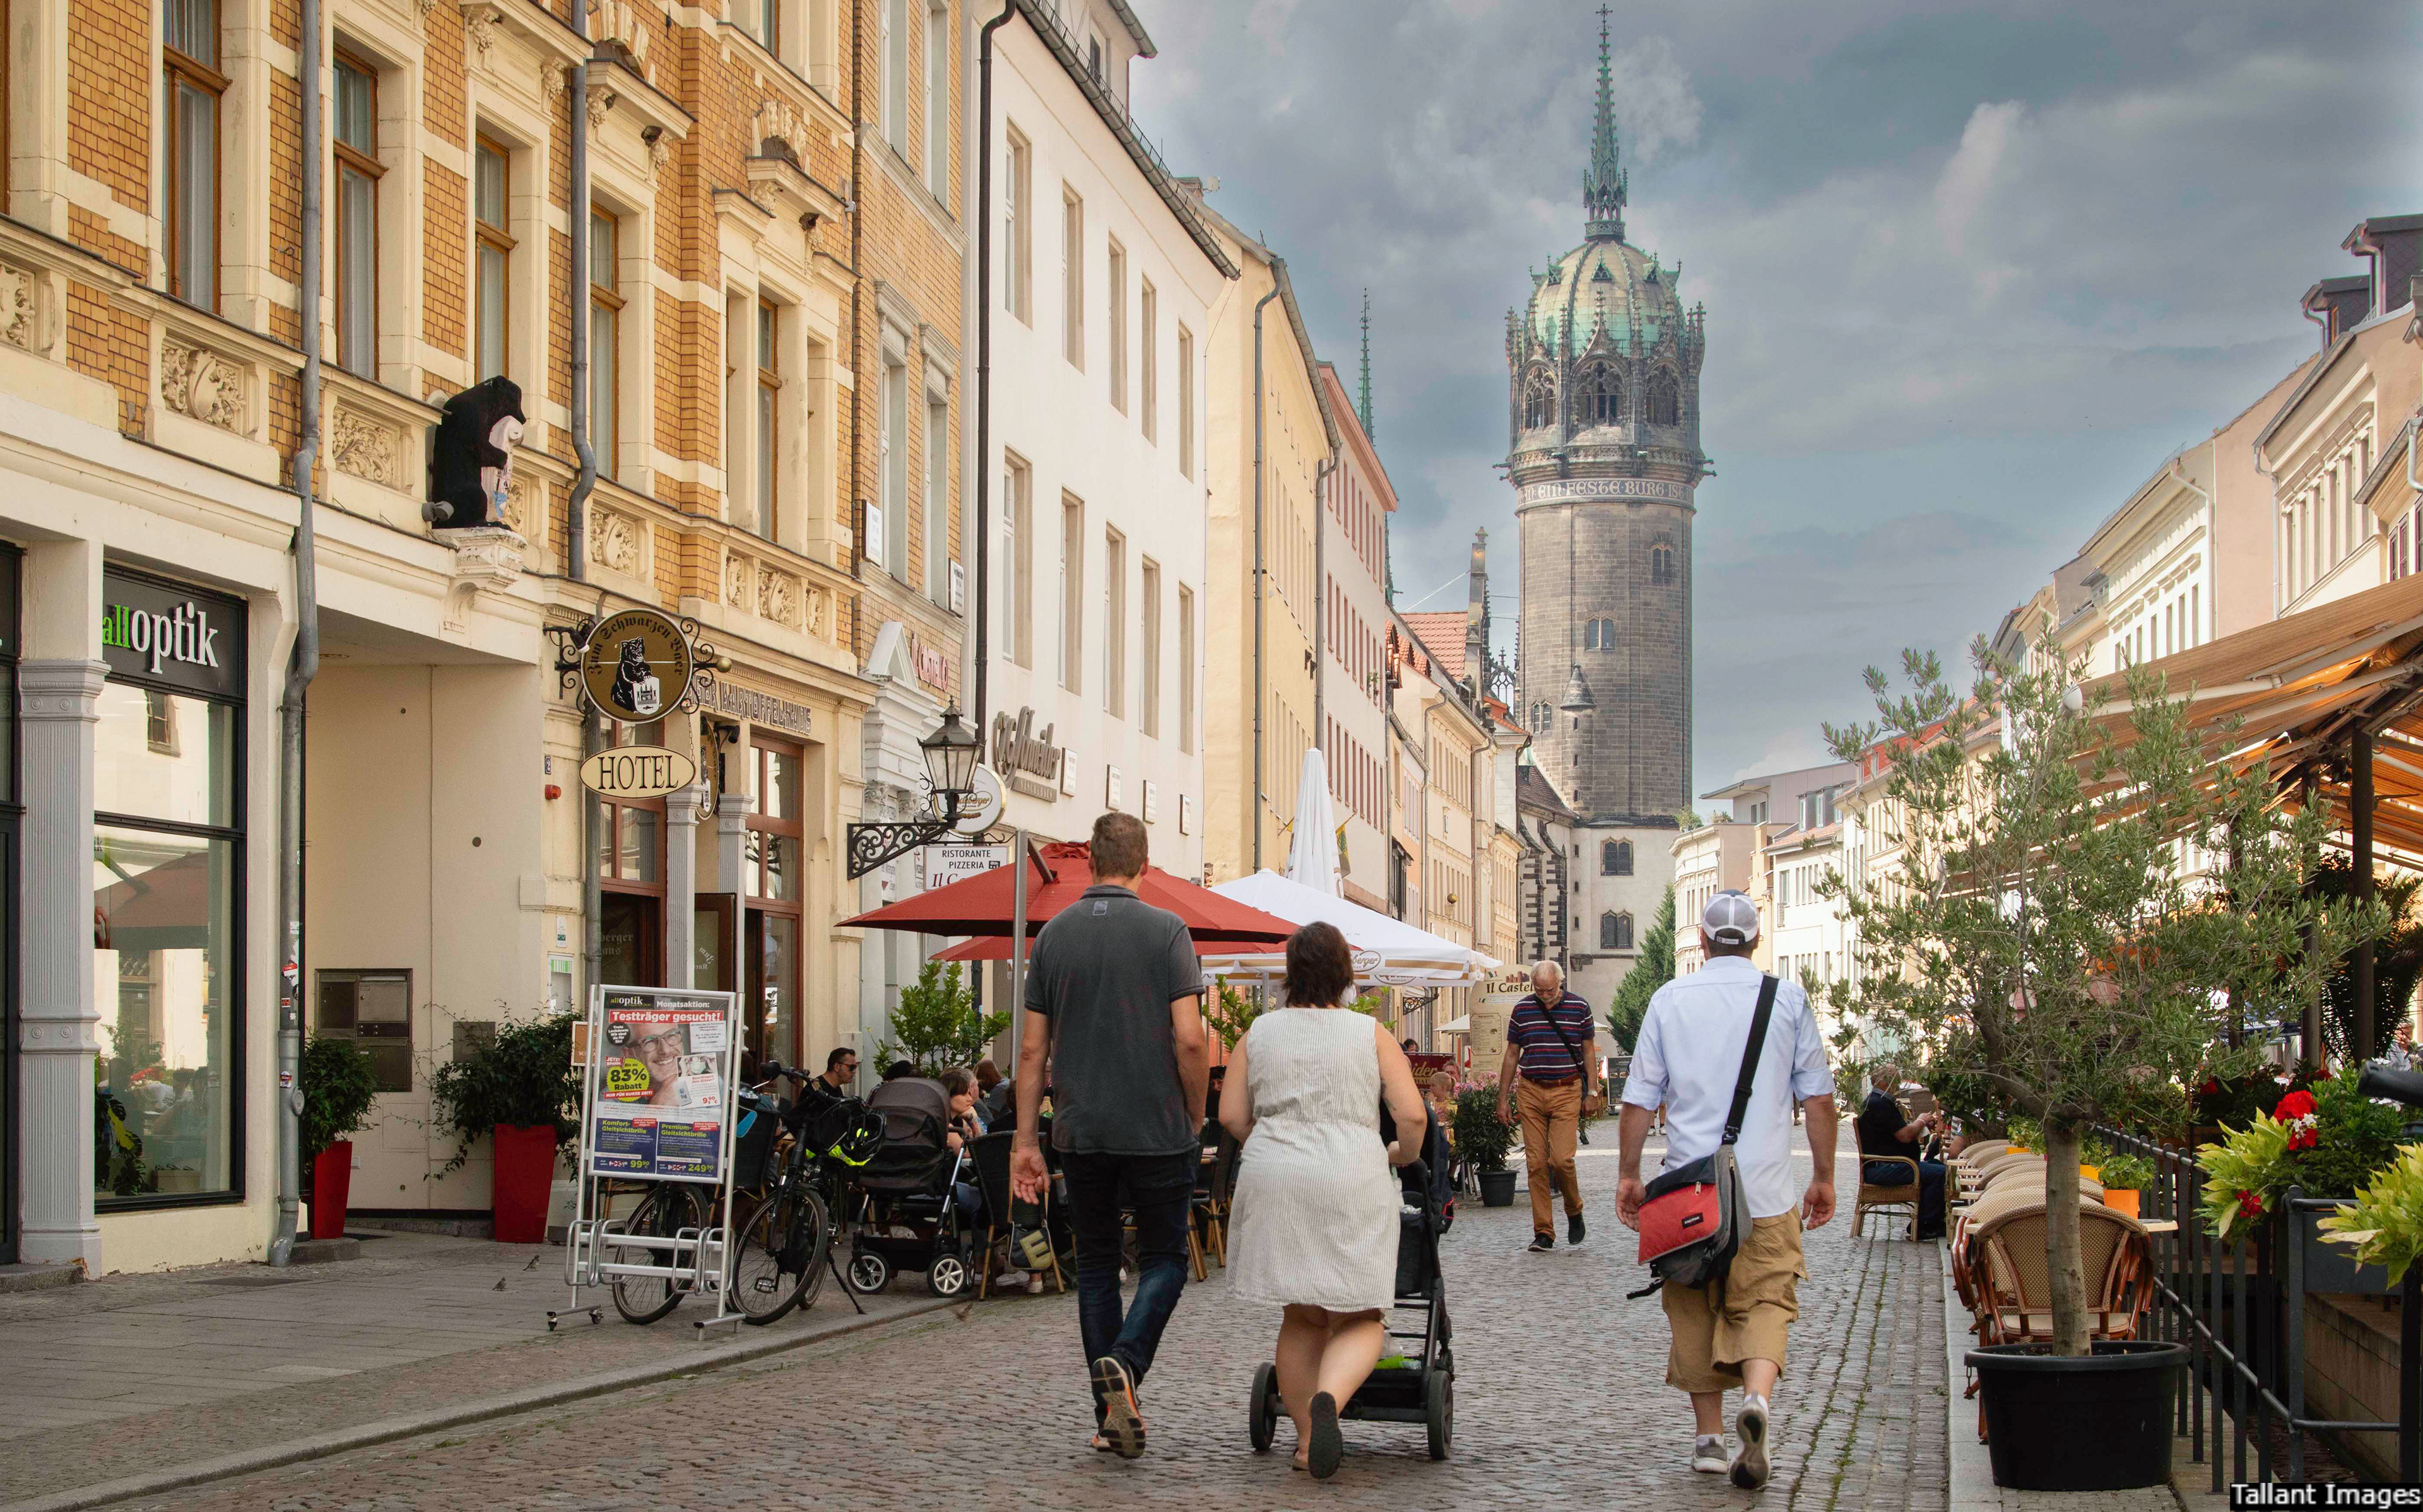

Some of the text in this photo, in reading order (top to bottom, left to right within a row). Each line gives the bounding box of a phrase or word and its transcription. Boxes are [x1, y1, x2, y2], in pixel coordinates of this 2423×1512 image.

[1625, 481, 1664, 496] BURG
[587, 616, 683, 676] Zum Schwarzen Baer
[598, 755, 678, 790] HOTEL
[942, 850, 991, 858] RISTORANTE
[949, 861, 984, 869] PIZZERIA
[931, 872, 943, 888] Il
[611, 996, 643, 1006] alloptik
[613, 1011, 721, 1023] Testträger gesucht!
[610, 1068, 647, 1082] 83%
